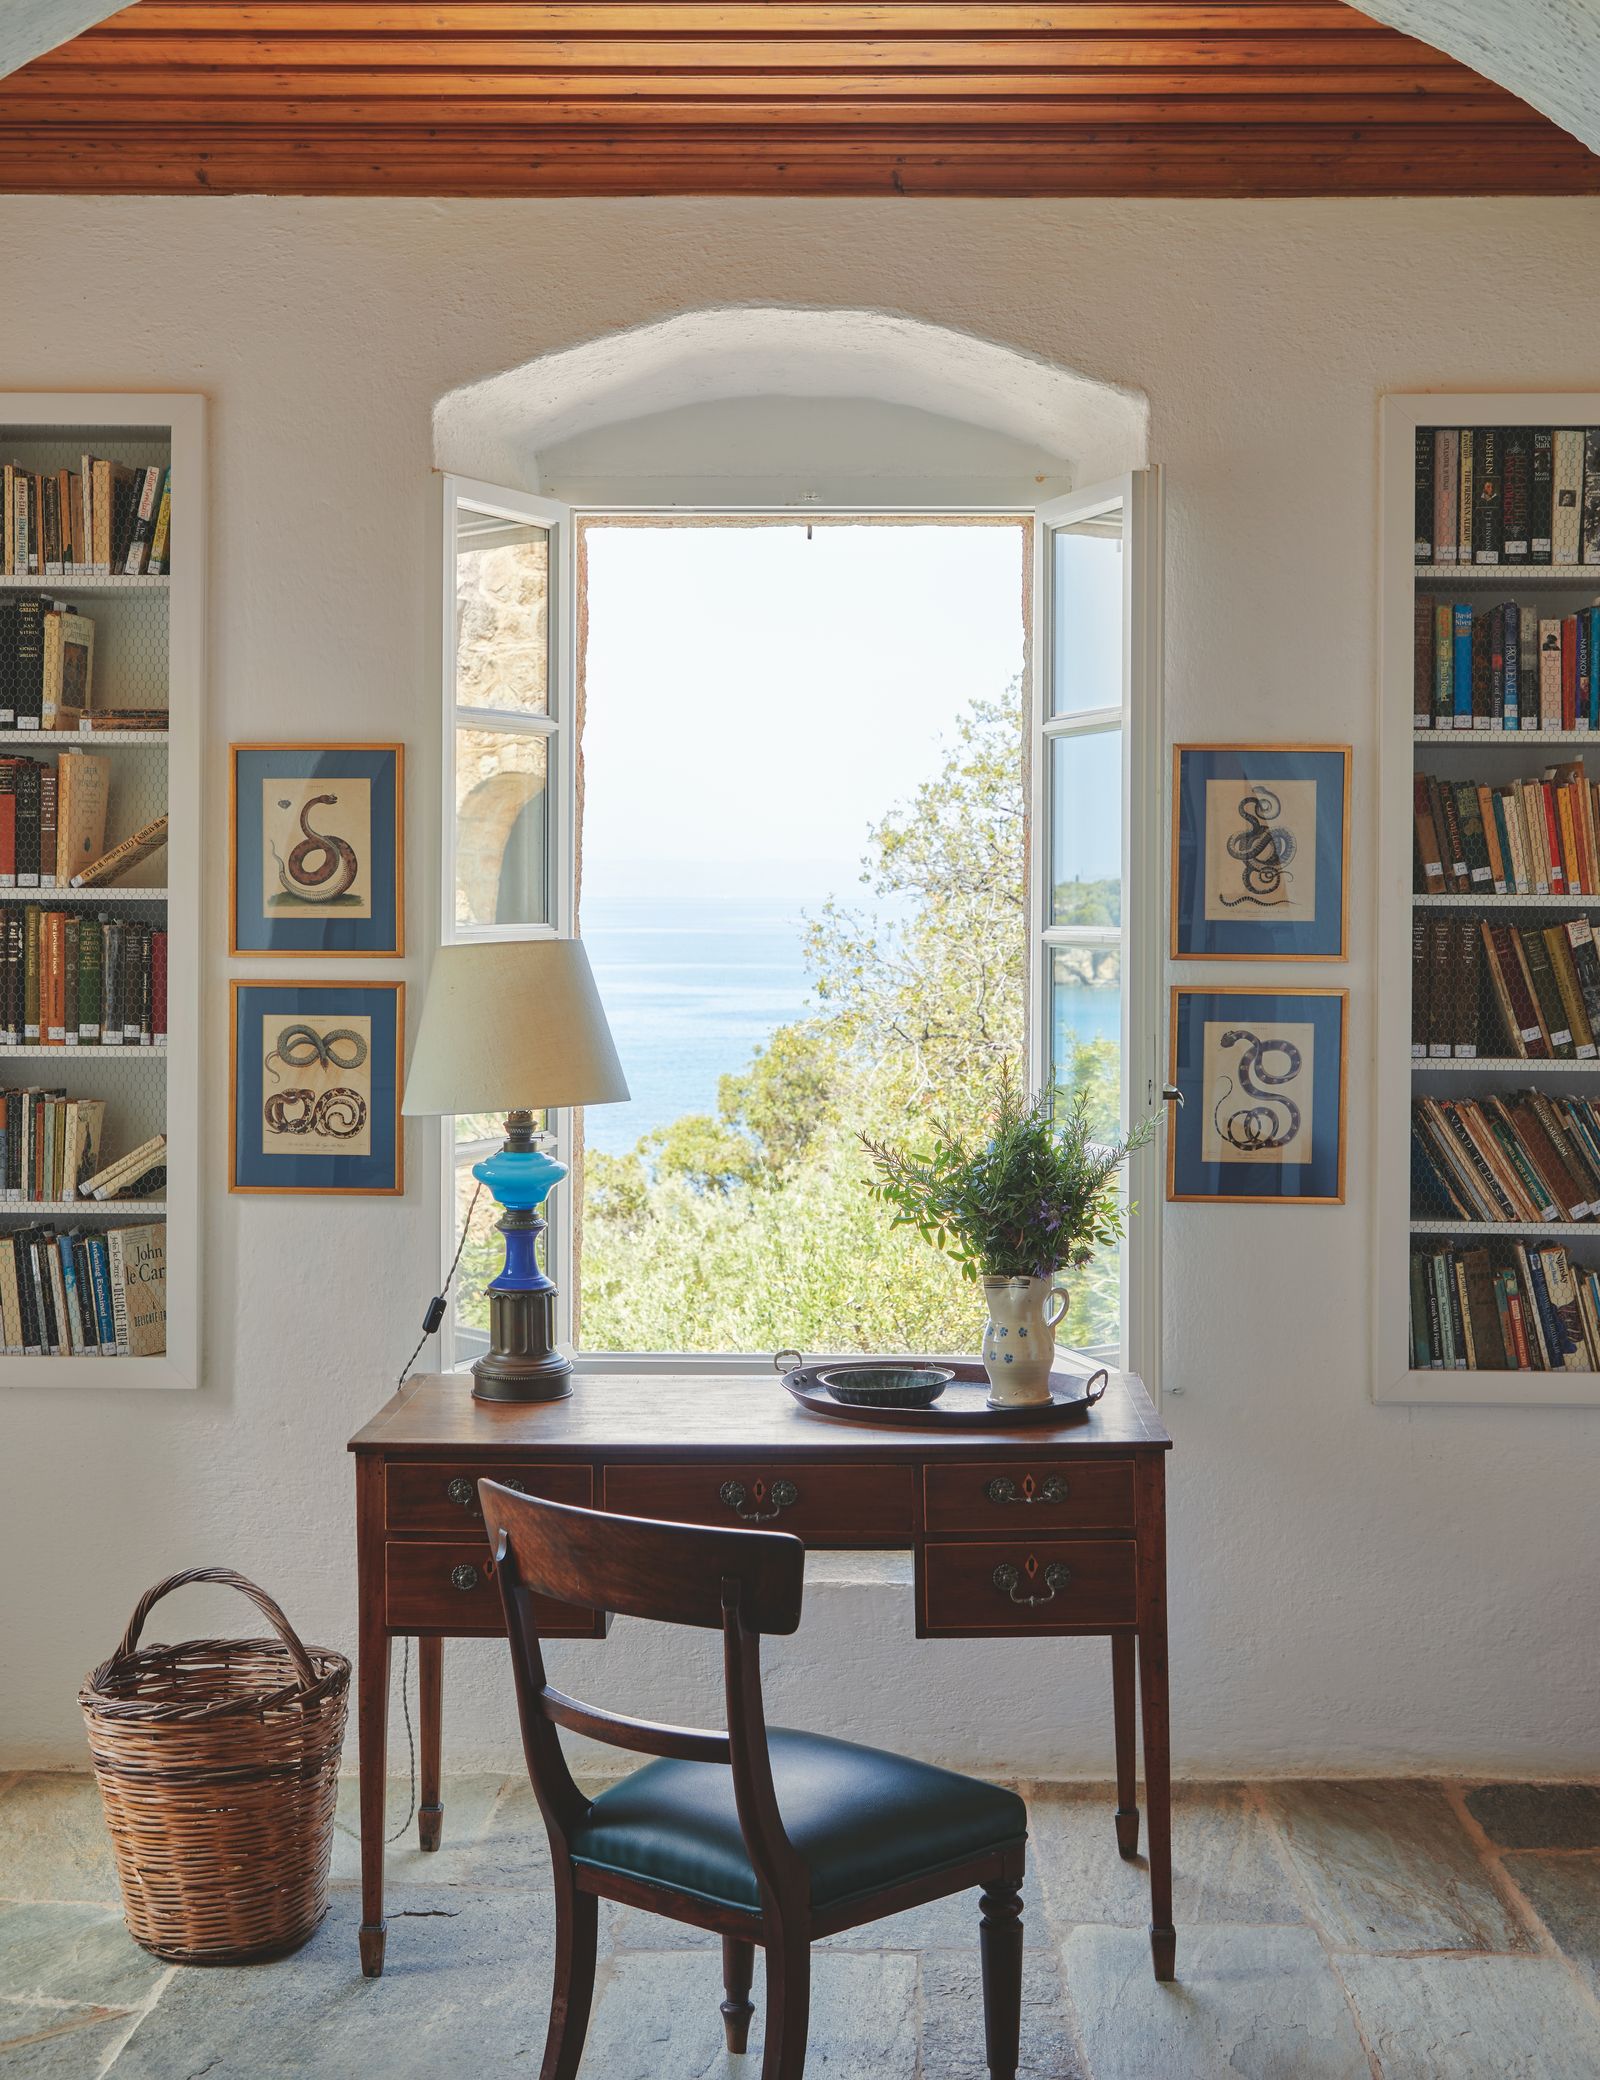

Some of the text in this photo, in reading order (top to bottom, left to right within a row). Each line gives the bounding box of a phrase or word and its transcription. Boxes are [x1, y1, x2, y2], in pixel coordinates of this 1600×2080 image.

[1535, 434, 1551, 442] Freya
[1535, 441, 1550, 449] Stark
[1485, 433, 1494, 474] PUSHKIN
[1455, 611, 1472, 619] David
[1579, 638, 1588, 677] NABOKOV
[1505, 643, 1517, 696] PROVIDENCE
[1440, 680, 1449, 702] Read
[103, 849, 121, 863] without
[1451, 1115, 1472, 1150] VLAD
[1533, 1100, 1568, 1156] BRITISH MUSEUM
[1513, 1158, 1526, 1173] SON
[110, 1234, 118, 1250] John
[136, 1243, 163, 1266] John
[112, 1257, 121, 1279] Carré
[126, 1266, 136, 1285] le
[1554, 1251, 1569, 1284] Nijinsky
[97, 1277, 107, 1318] Explained
[114, 1287, 125, 1320] DELICATE
[1429, 1296, 1437, 1316] Greek
[134, 1311, 158, 1327] DELICATE
[117, 1323, 128, 1346] TRUTH
[1432, 1332, 1440, 1356] Flowers
